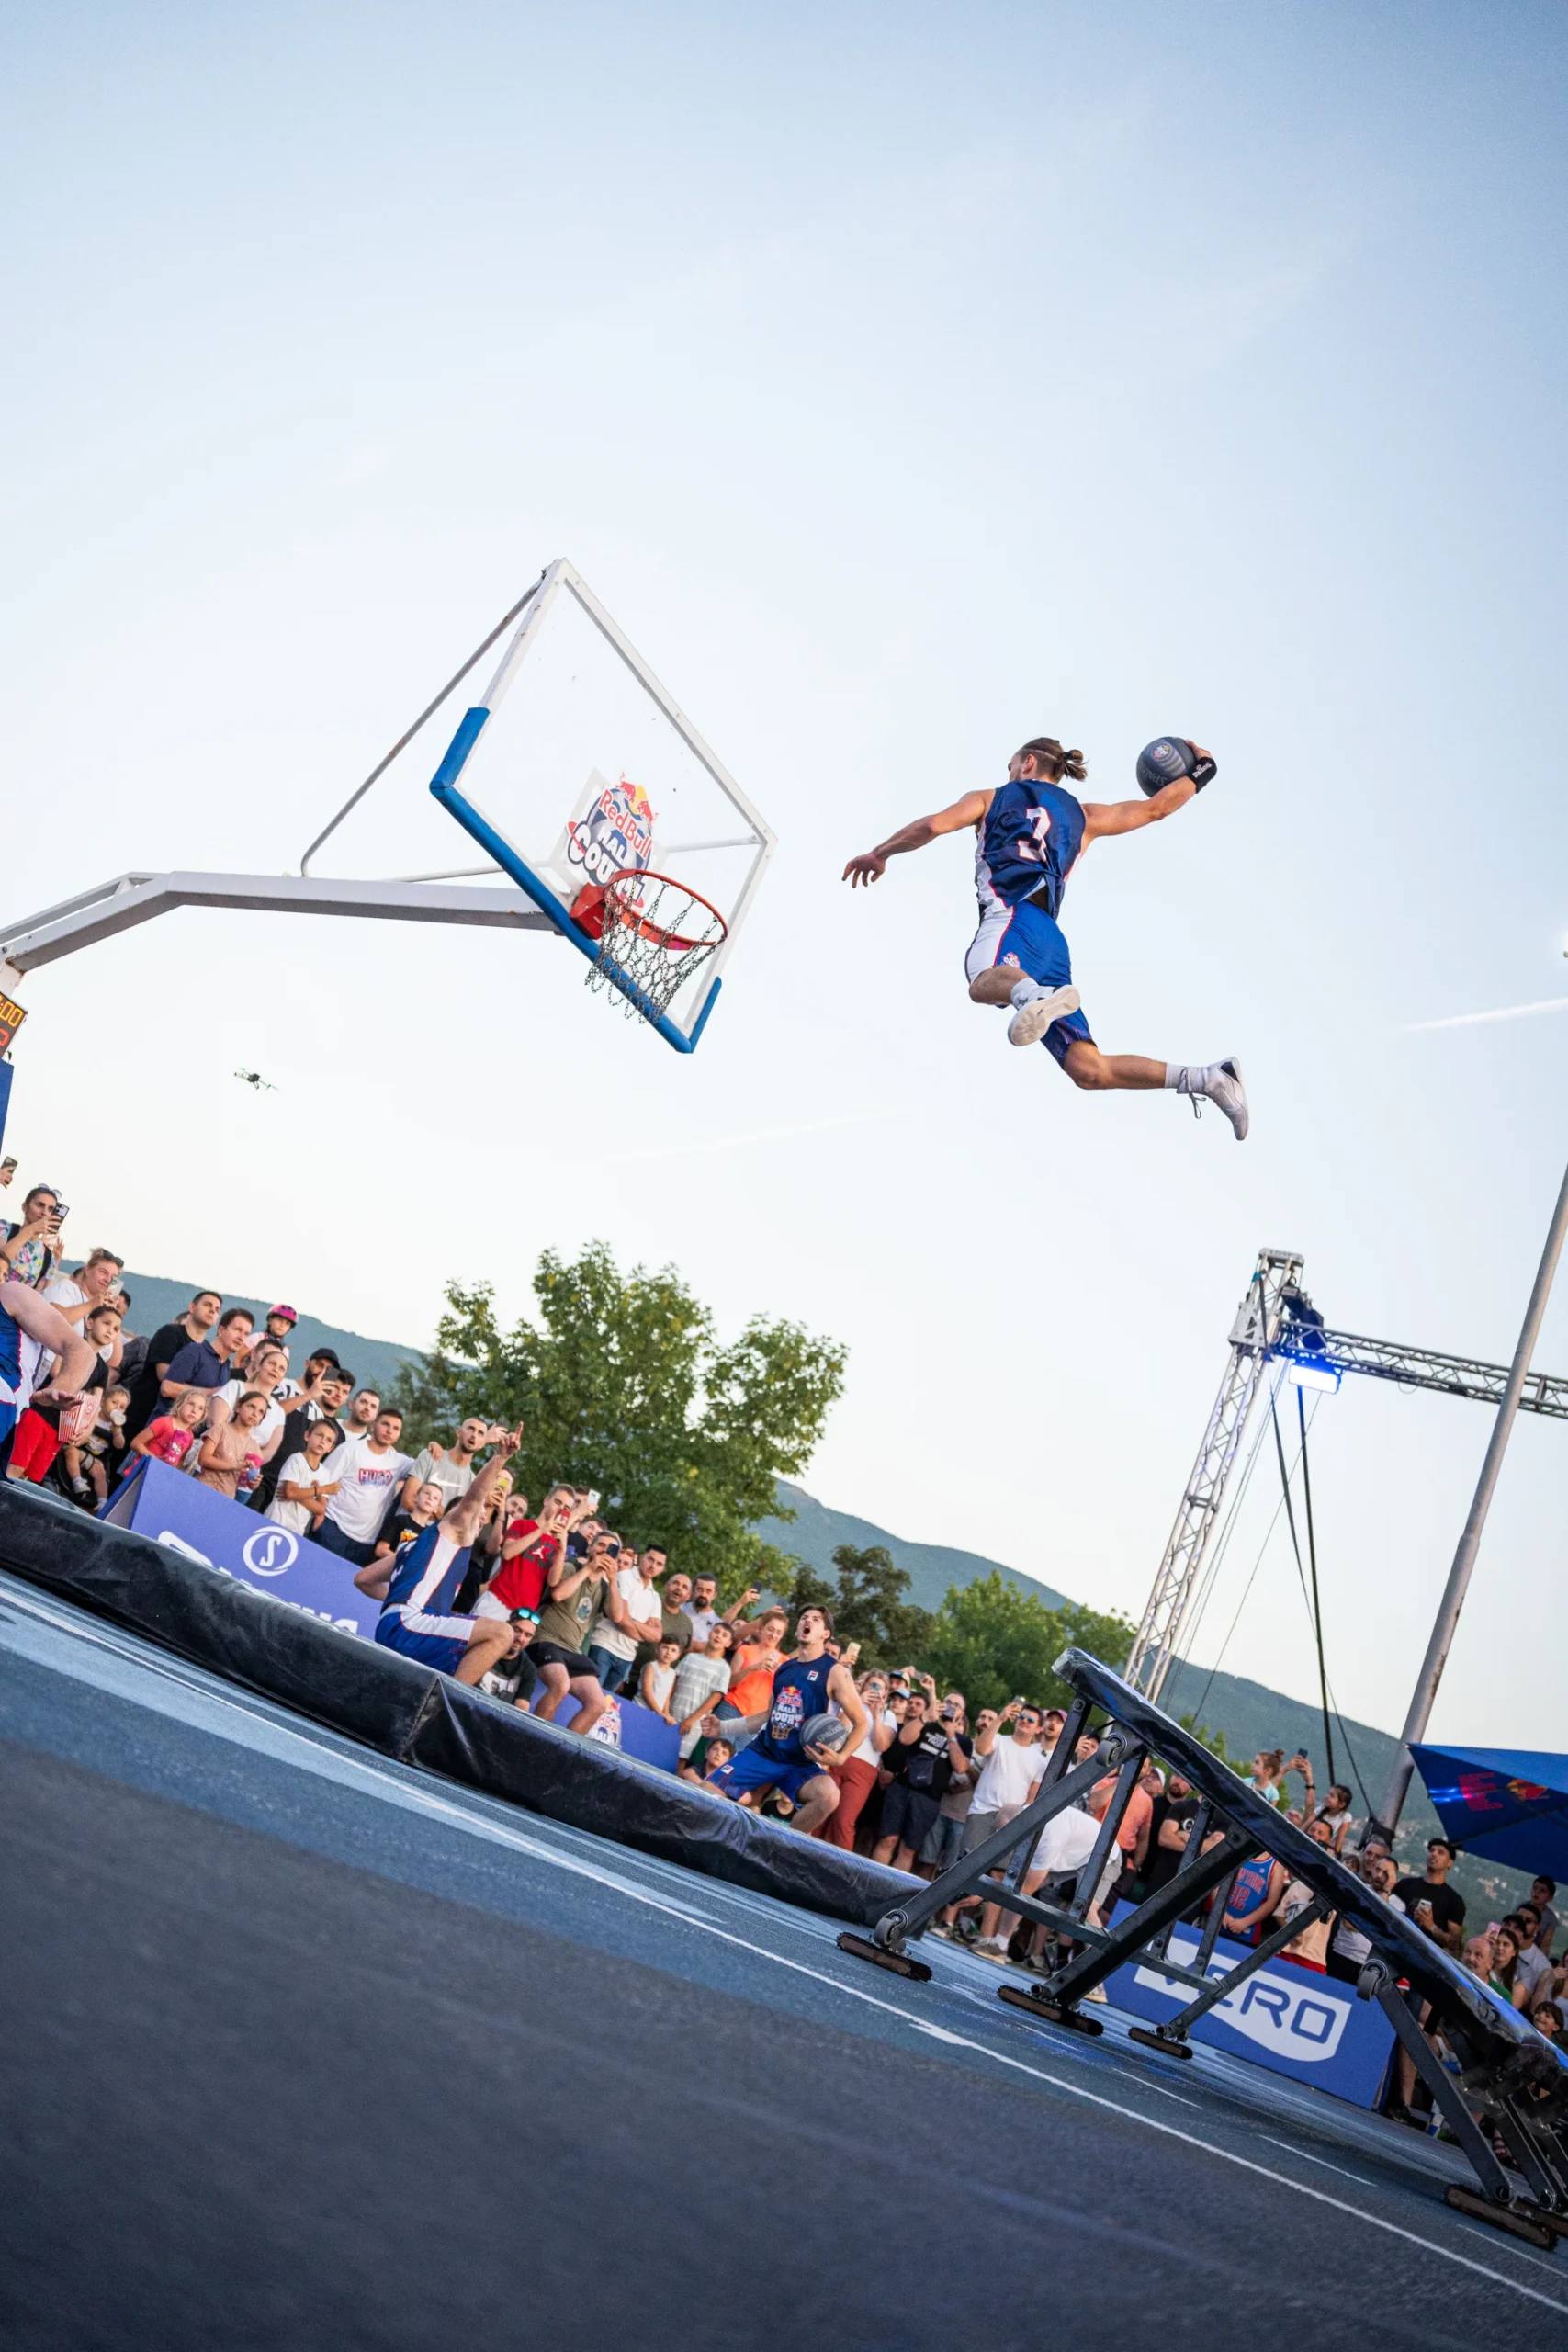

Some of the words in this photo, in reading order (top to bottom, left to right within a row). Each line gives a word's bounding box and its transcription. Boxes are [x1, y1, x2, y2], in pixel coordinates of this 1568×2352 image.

[599, 789, 628, 831] Red
[625, 820, 652, 858] Bull
[1018, 809, 1051, 862] 3
